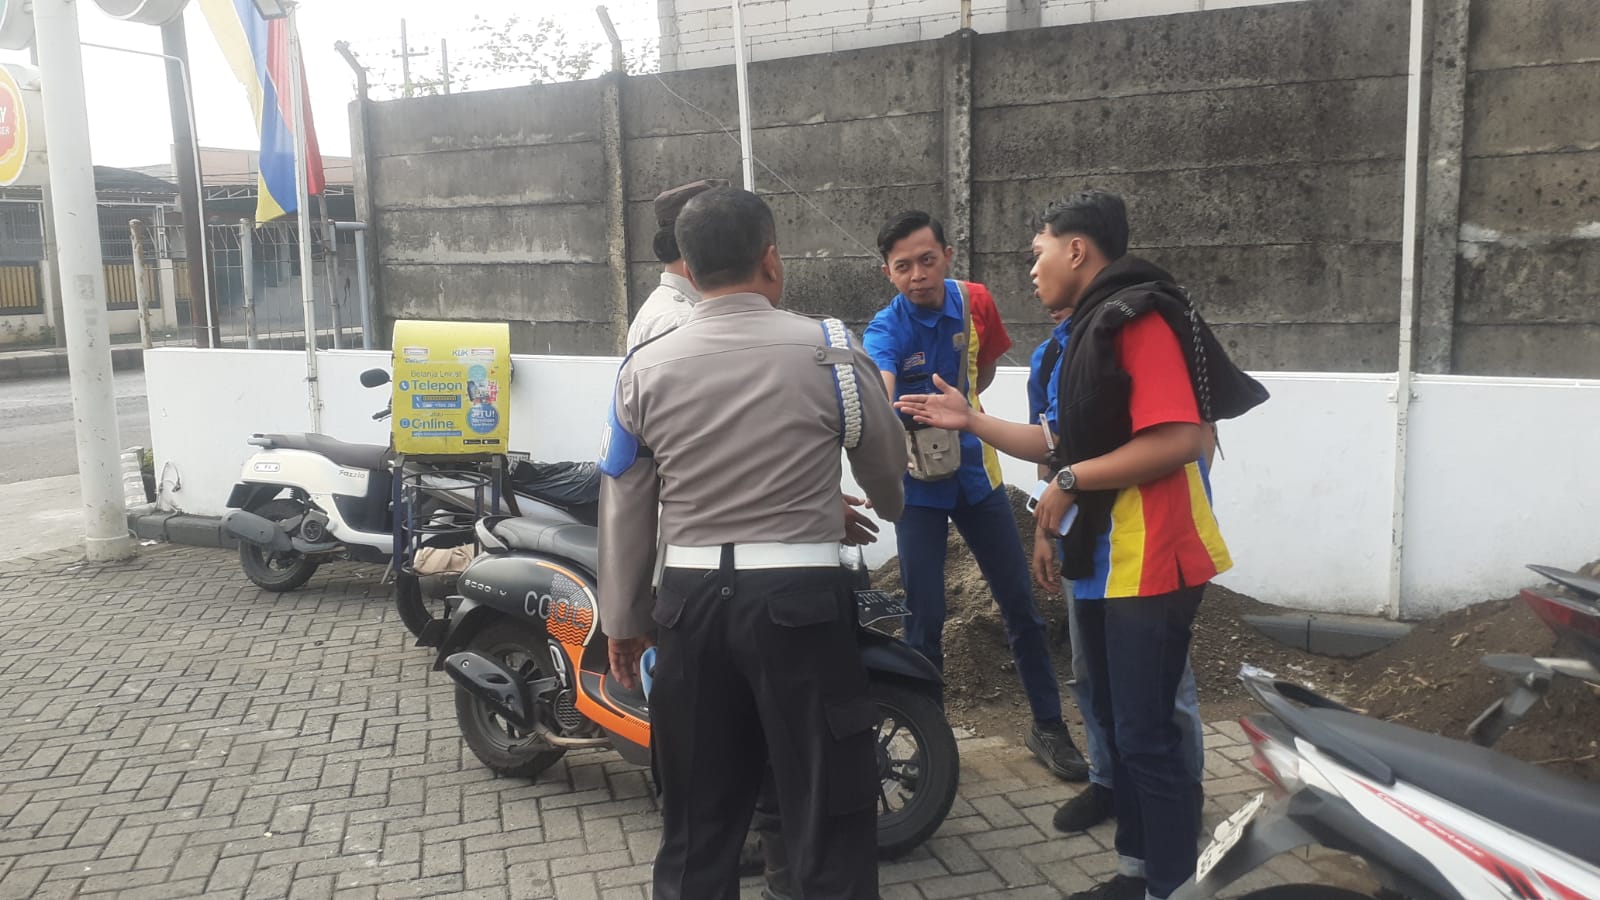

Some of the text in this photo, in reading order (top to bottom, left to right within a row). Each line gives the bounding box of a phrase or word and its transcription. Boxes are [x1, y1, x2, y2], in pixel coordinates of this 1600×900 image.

[412, 380, 462, 392] Telepon
[412, 418, 454, 429] Online
[338, 469, 366, 479] Fazzio
[465, 579, 507, 596] SCOOY
[525, 590, 586, 628] COOL
